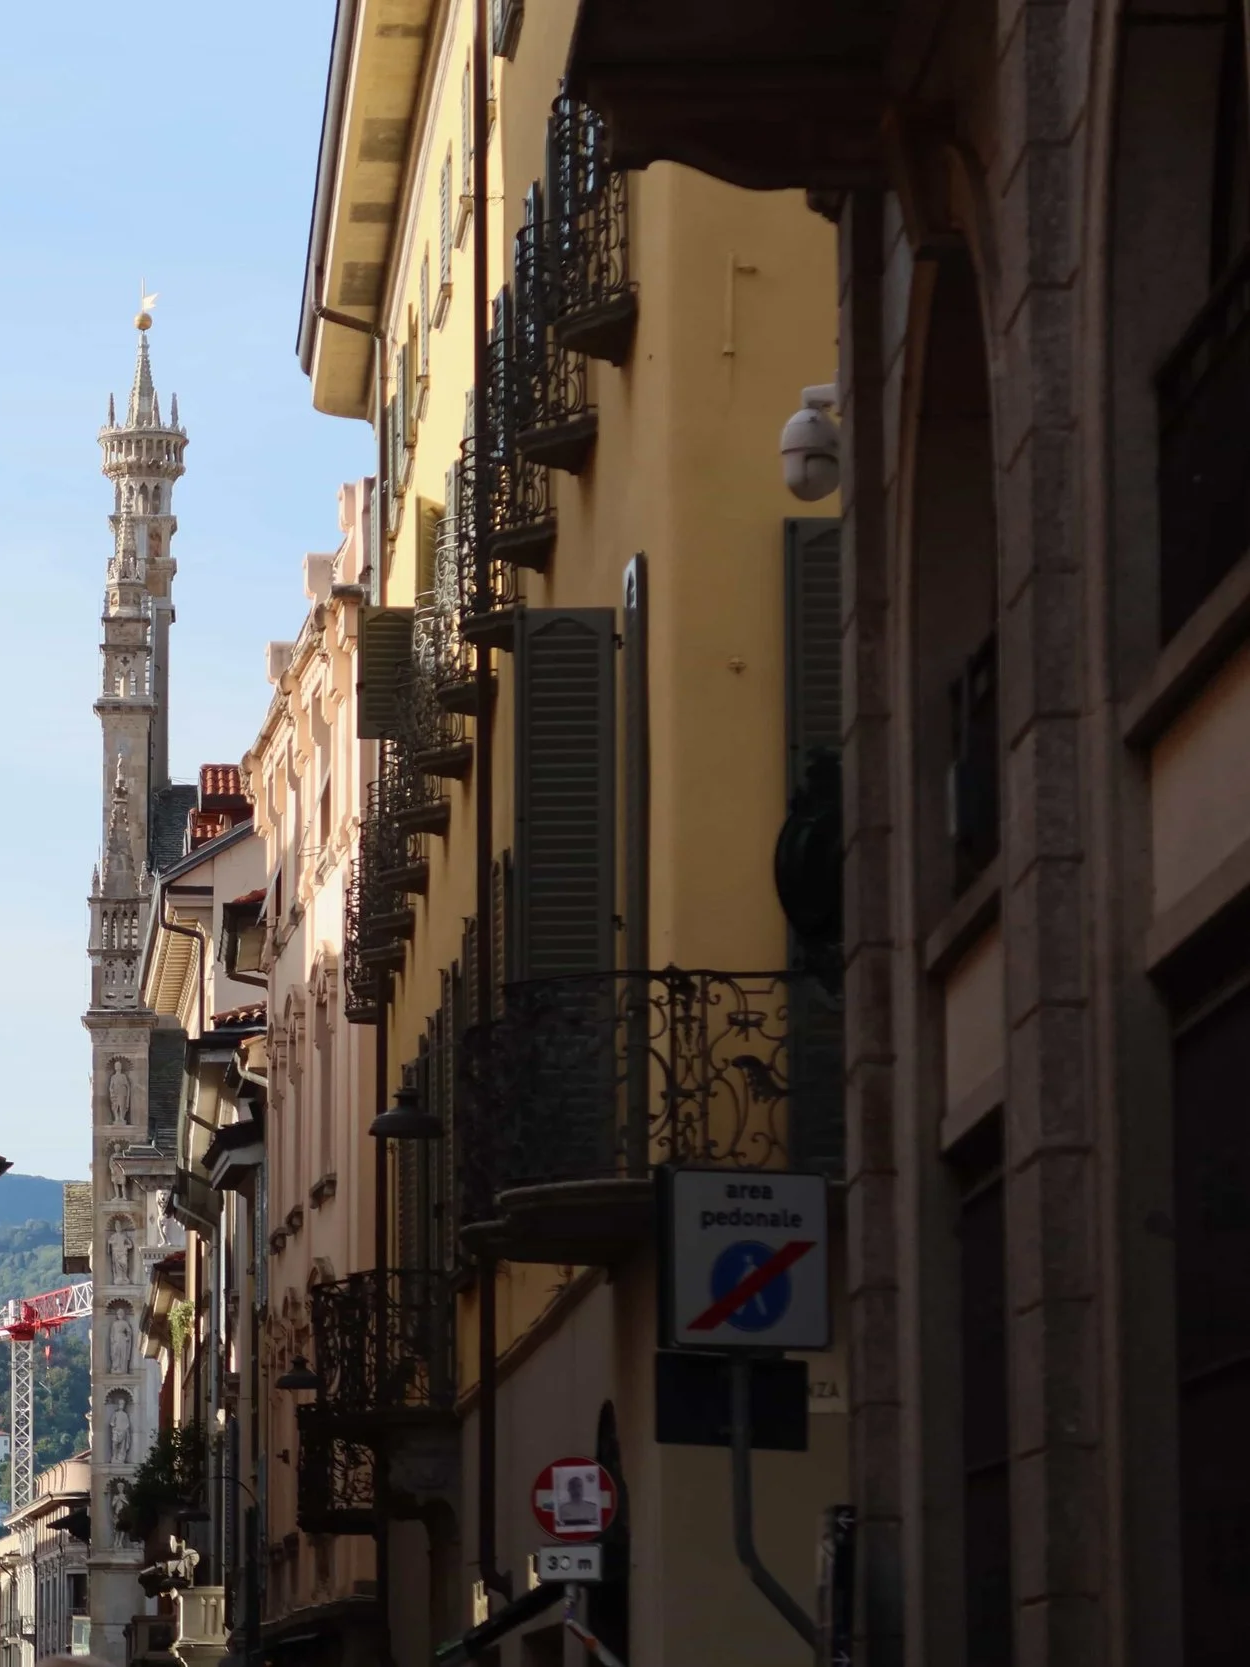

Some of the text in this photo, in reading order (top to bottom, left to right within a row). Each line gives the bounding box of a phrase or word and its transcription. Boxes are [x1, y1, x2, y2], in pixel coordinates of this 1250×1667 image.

[725, 1184, 774, 1200] area
[700, 1207, 803, 1230] pedonale
[577, 1558, 592, 1571] m
